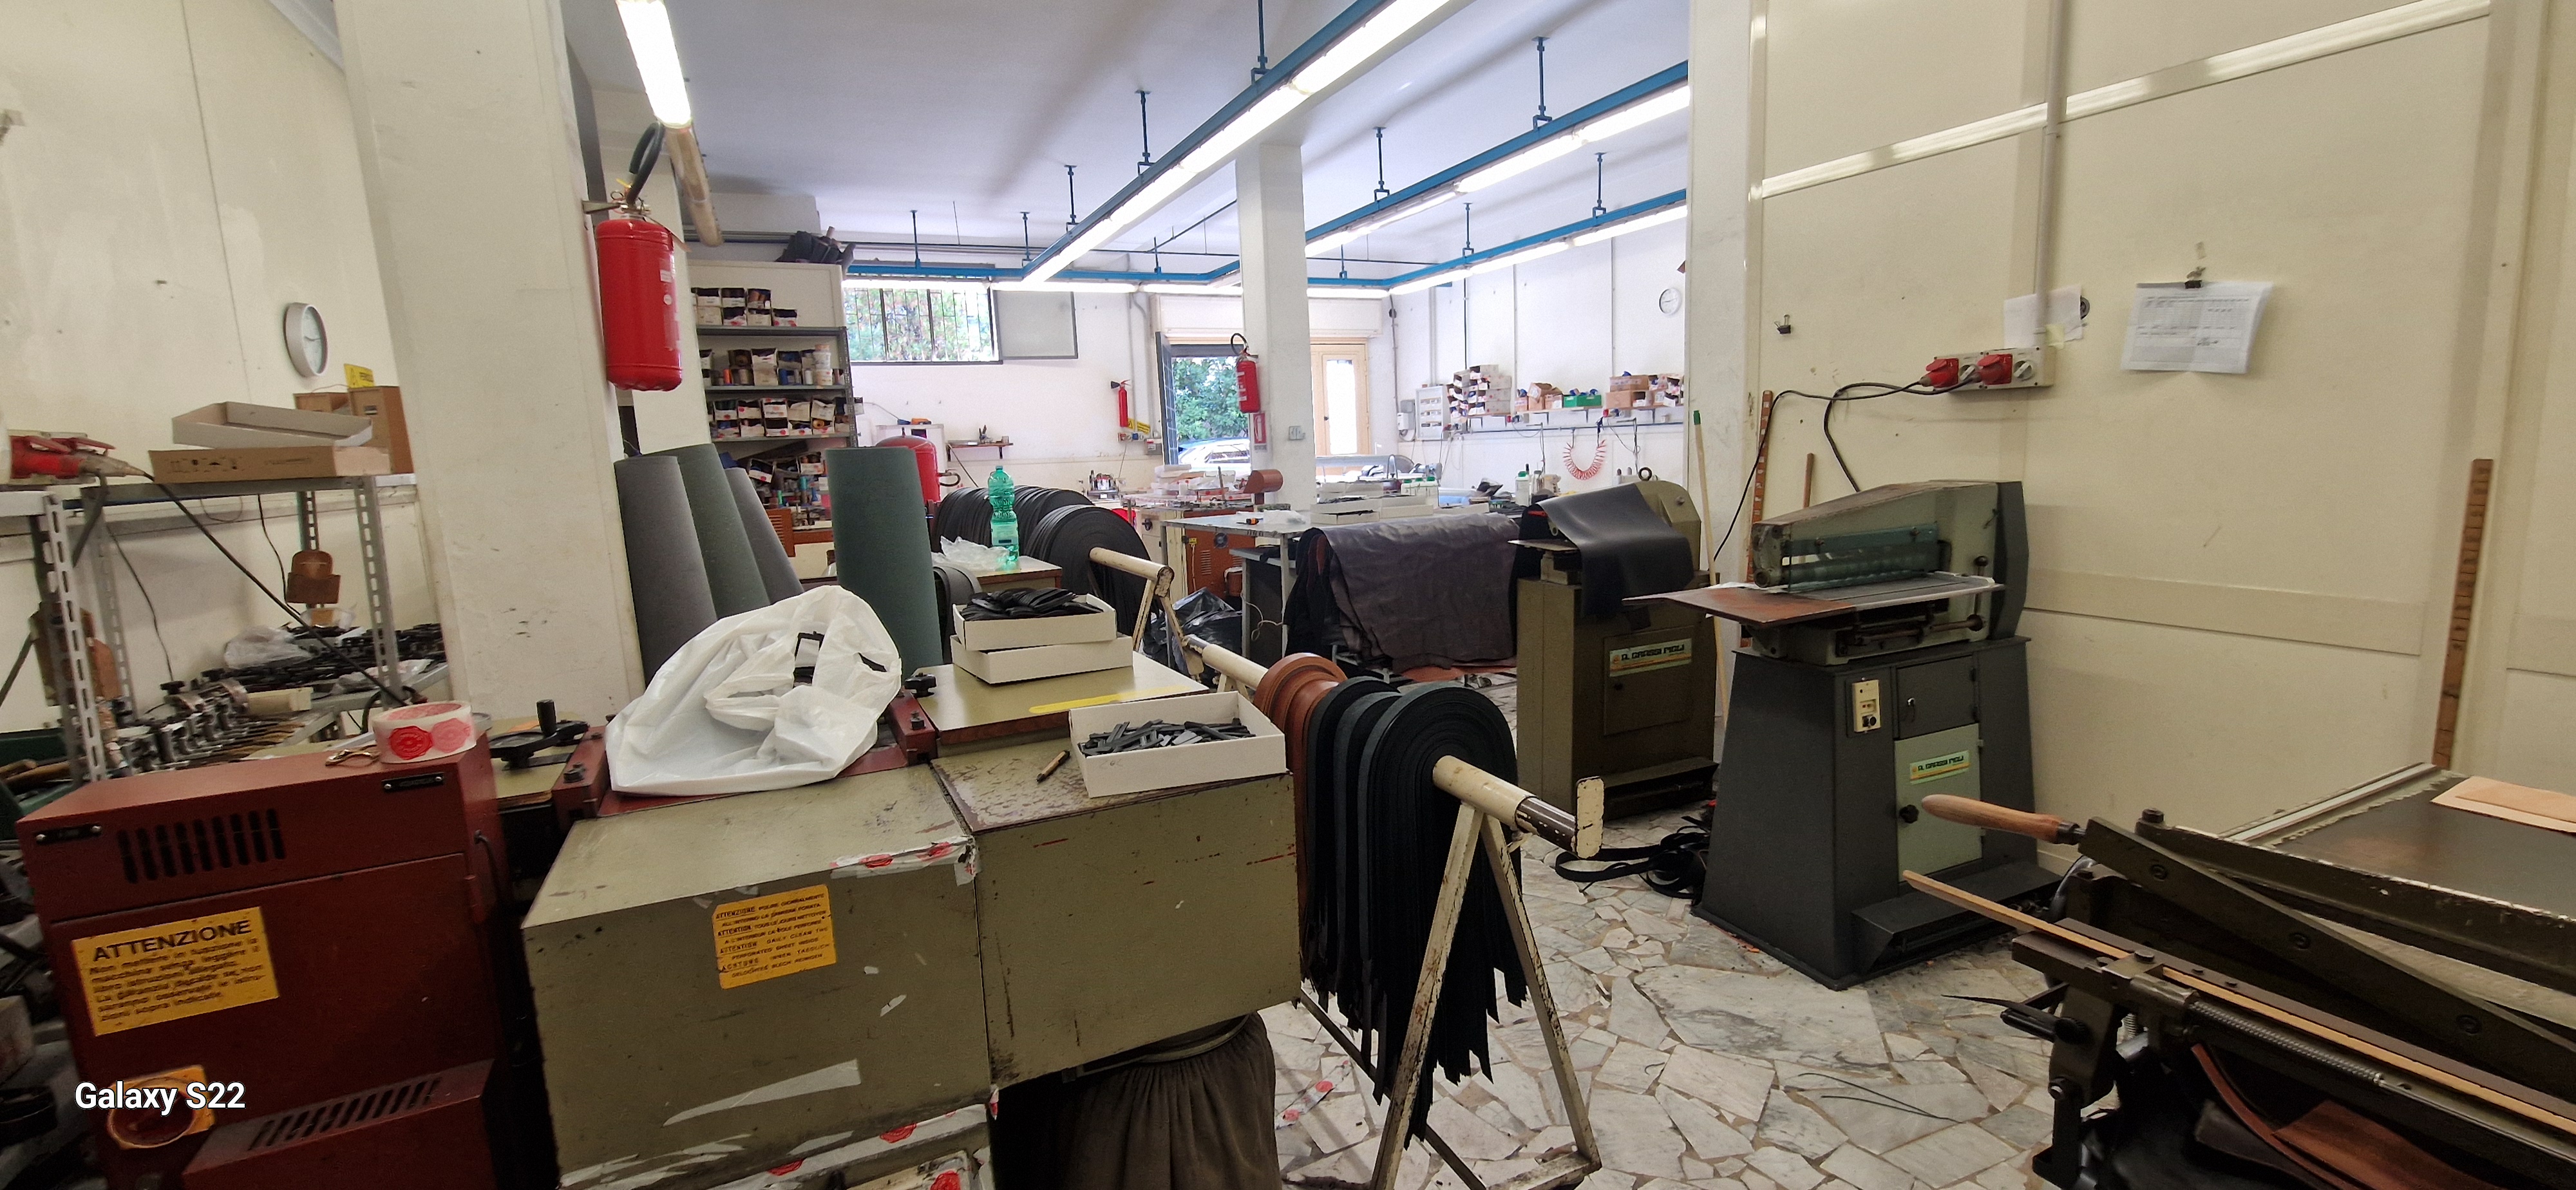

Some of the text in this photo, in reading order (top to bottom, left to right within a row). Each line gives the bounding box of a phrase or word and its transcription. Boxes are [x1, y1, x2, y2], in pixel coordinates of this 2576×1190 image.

[715, 907, 755, 919] ATTENZIONE
[717, 925, 751, 936] ATTENTION
[93, 920, 252, 961] ATTENZIONE
[719, 941, 757, 953] ATTENTION
